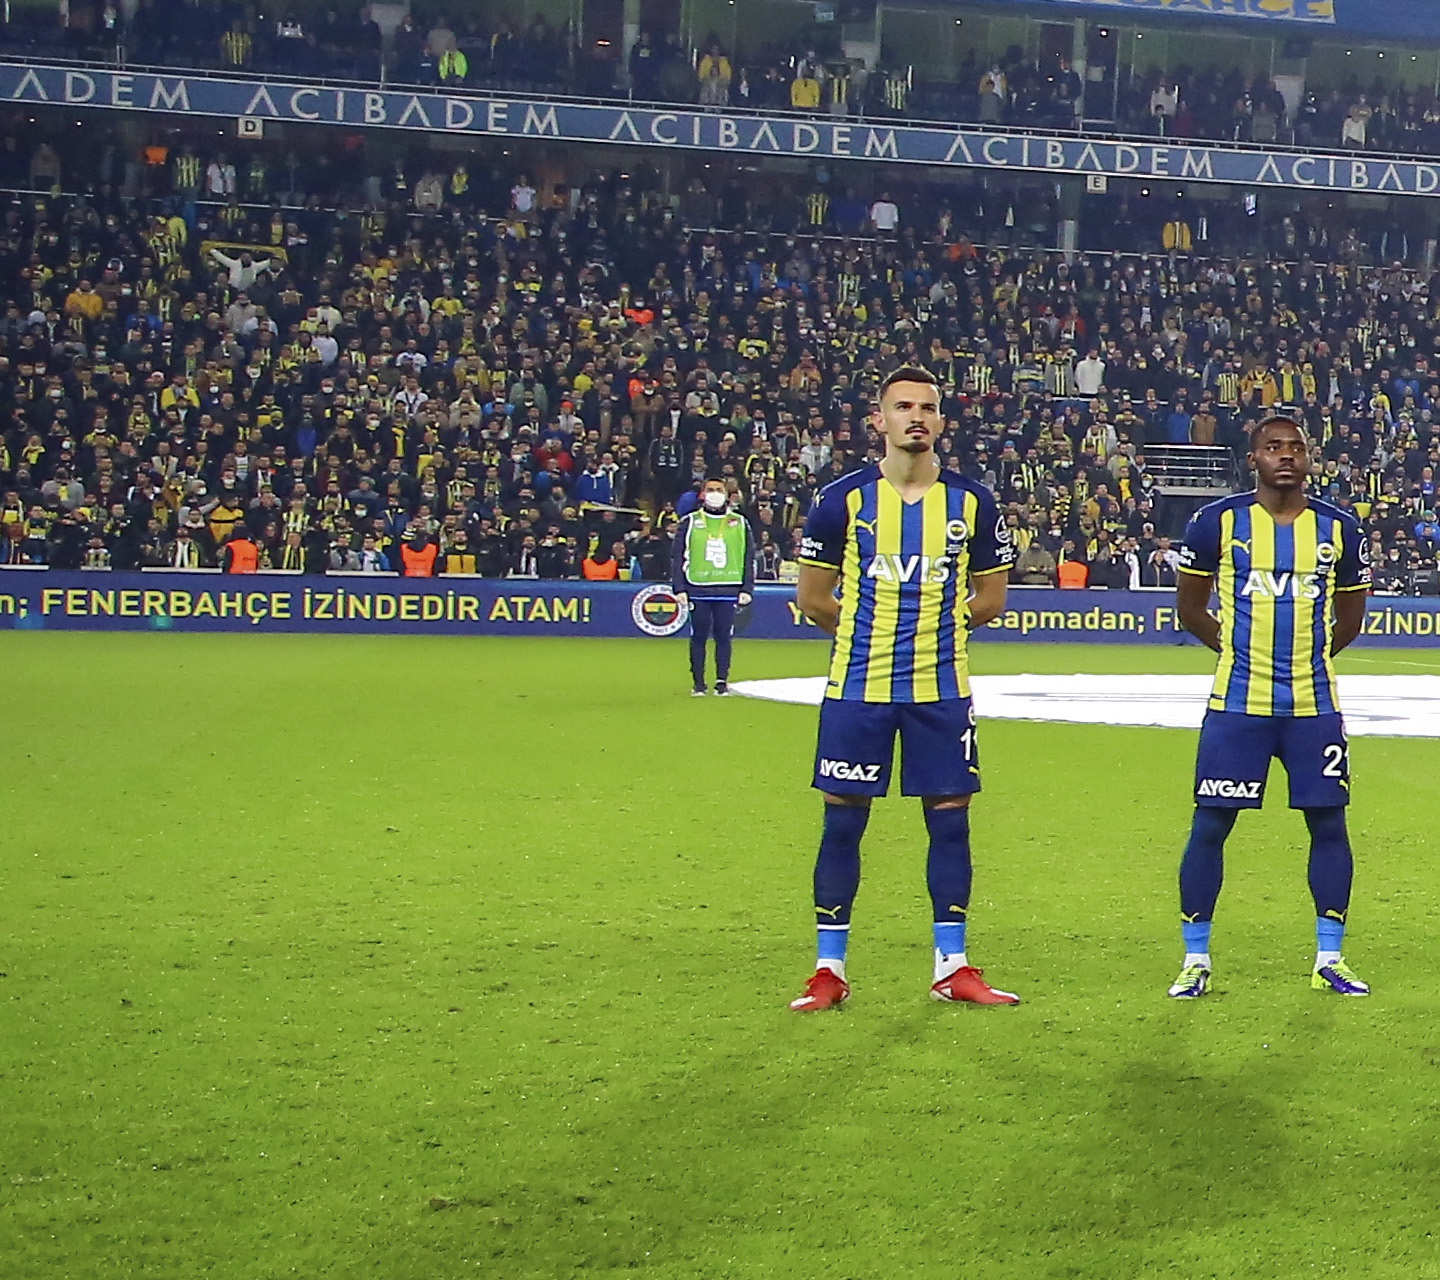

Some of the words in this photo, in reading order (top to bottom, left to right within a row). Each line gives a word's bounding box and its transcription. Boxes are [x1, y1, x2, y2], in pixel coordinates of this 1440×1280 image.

[13, 66, 191, 111] ADEM
[244, 83, 561, 137] ACIBADEM
[609, 111, 899, 159] ACIBADEM
[944, 133, 1214, 179] ACIBADEM
[866, 553, 952, 583] AVIS
[1241, 570, 1322, 600] AVIS
[41, 587, 291, 626] FENERBAHÇE
[302, 587, 480, 622] İZİNDEDİR
[488, 596, 592, 624] ATAM!
[986, 607, 1146, 635] sapmadan;
[1196, 777, 1263, 799] AYGAZ
